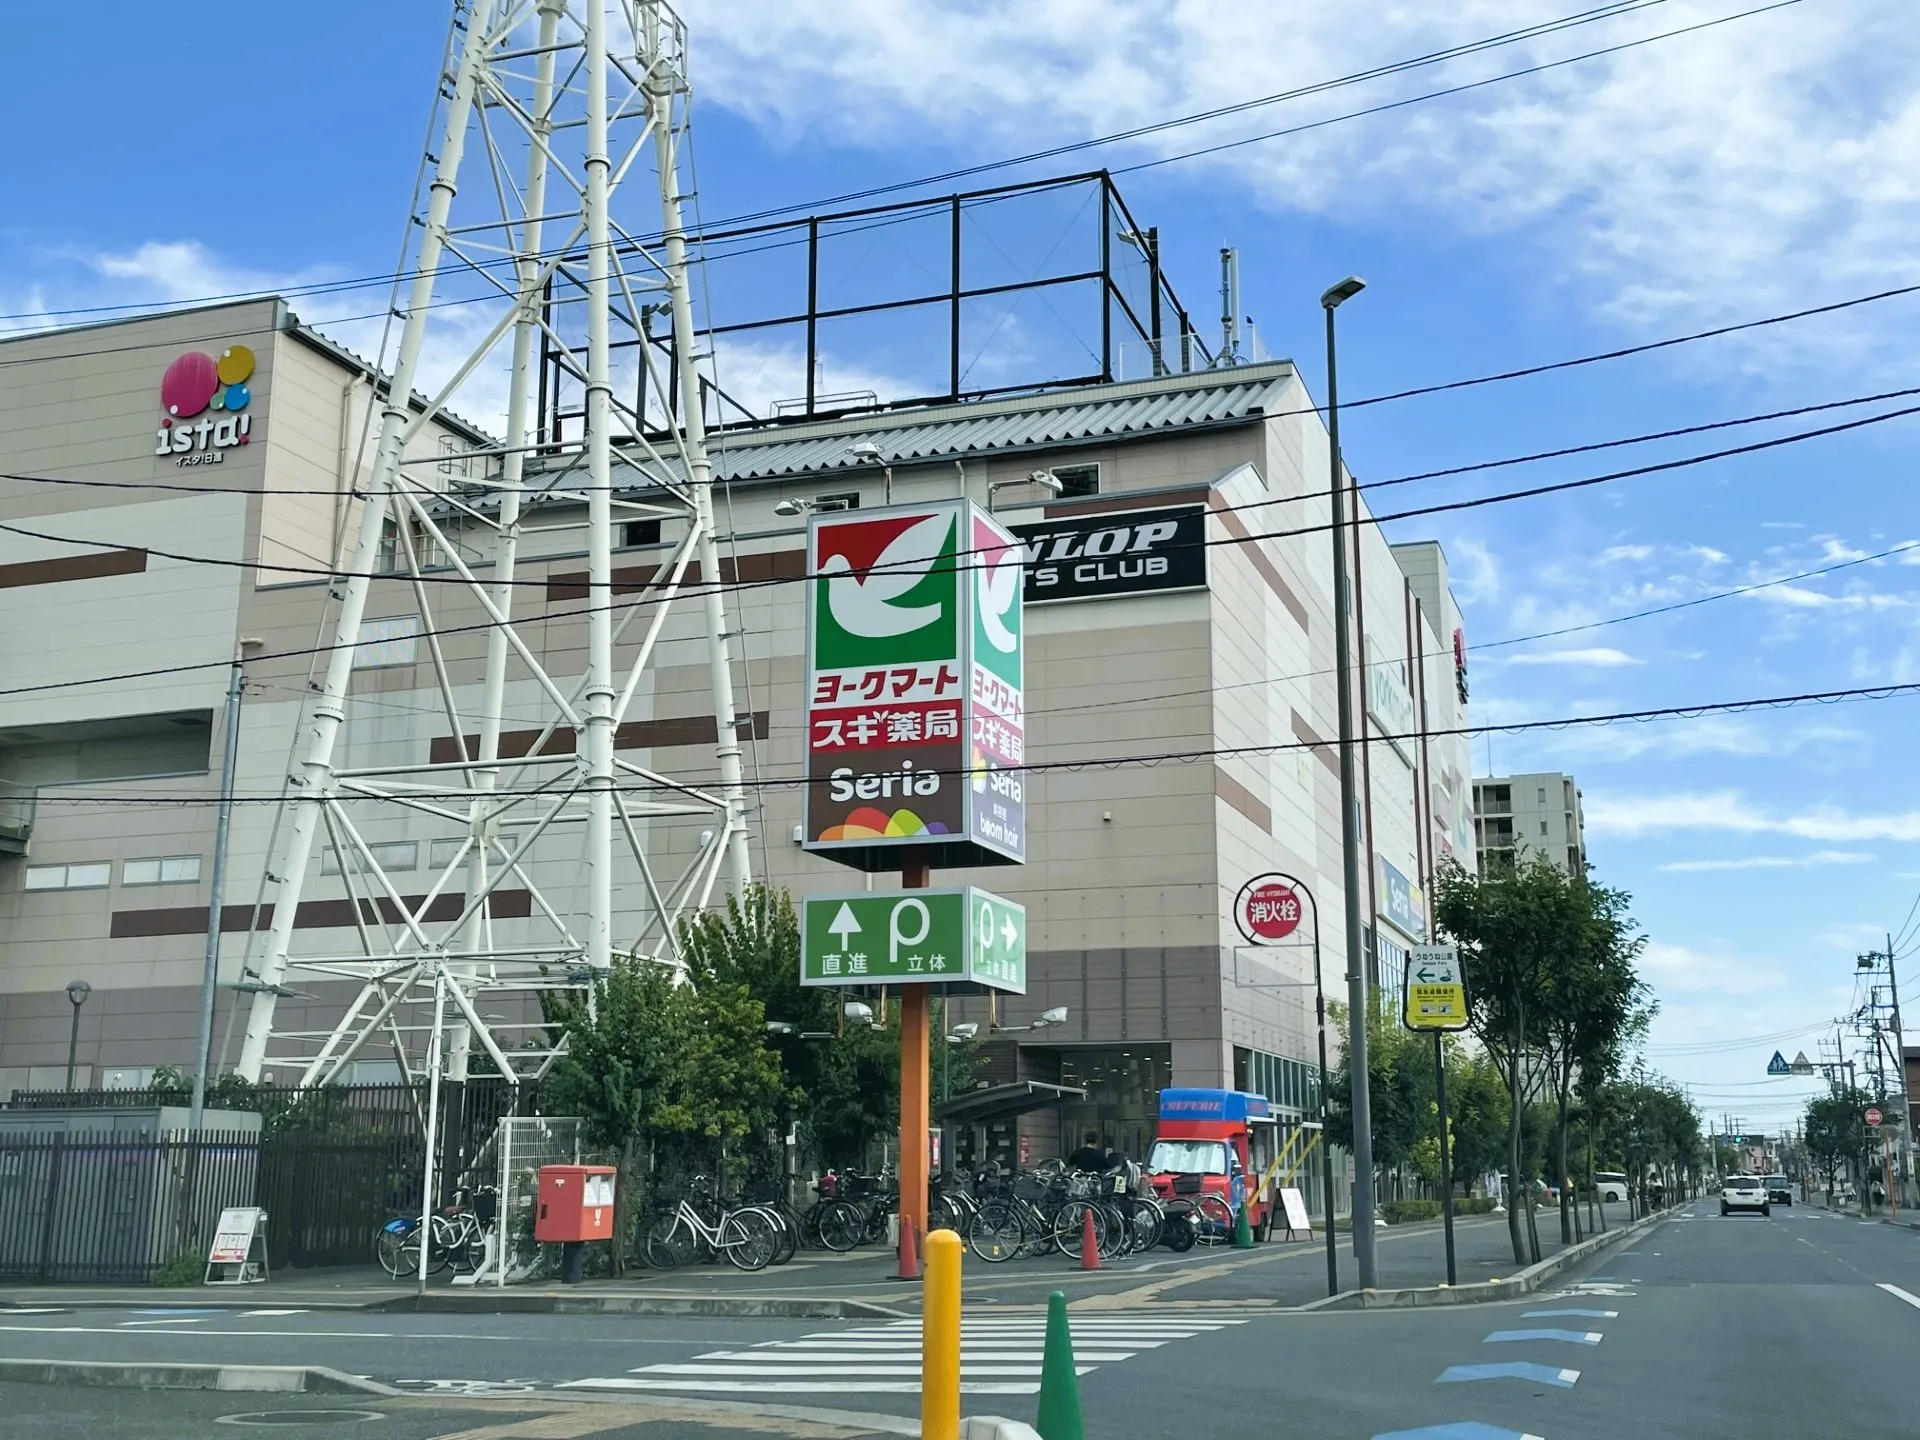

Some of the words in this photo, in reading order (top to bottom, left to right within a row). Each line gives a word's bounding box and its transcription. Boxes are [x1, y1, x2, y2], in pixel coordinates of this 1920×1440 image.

[156, 413, 252, 455] ista!
[1074, 556, 1168, 583] CLUB
[813, 665, 958, 704] ヨークマート
[973, 668, 1022, 722] ヨークマート
[813, 709, 958, 748] スギ薬局
[973, 713, 1022, 765] スギ薬局
[829, 760, 940, 802] Seria
[990, 762, 1022, 803] Seria
[980, 810, 1003, 842] boom
[889, 898, 931, 963] P
[1250, 899, 1298, 923] 消火栓
[821, 952, 869, 975] 直進
[907, 953, 947, 972] 立体
